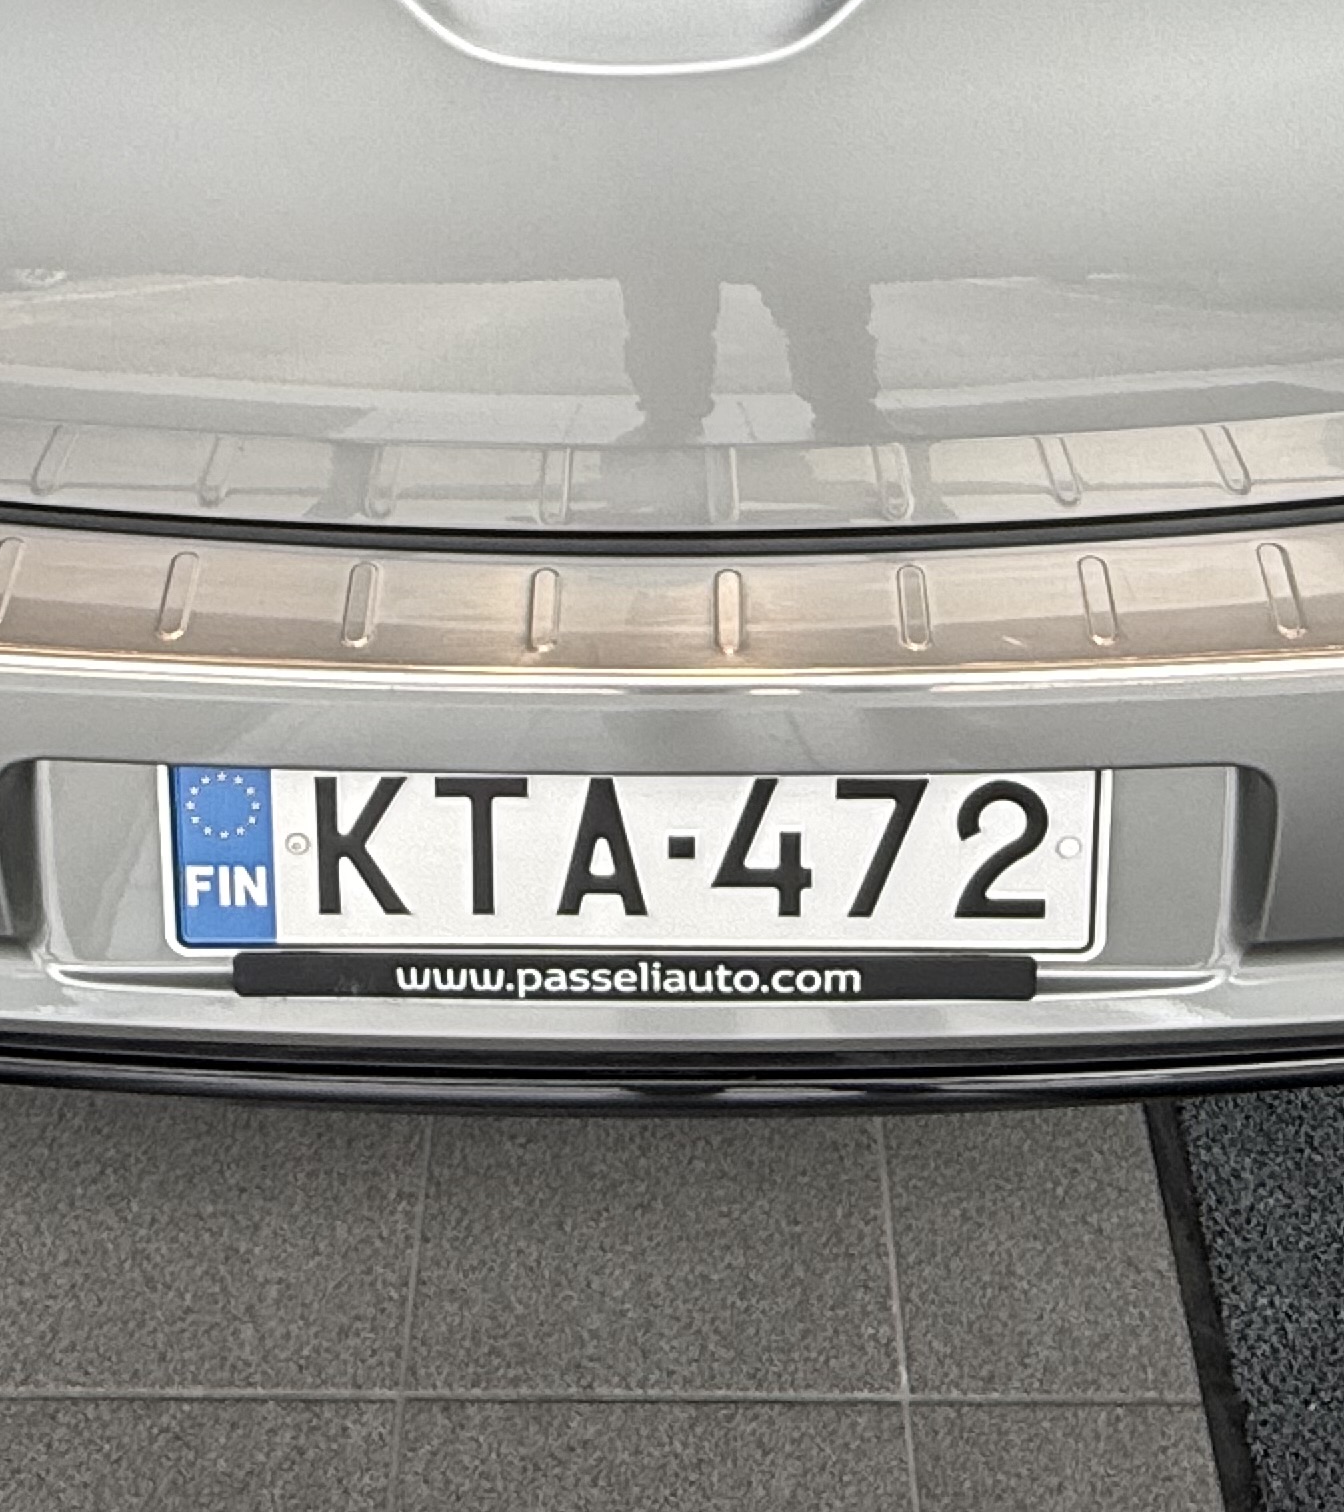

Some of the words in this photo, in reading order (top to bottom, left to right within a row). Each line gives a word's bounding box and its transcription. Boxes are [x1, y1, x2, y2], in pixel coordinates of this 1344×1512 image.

[313, 775, 1049, 919] KTA-472
[184, 864, 269, 908] FIN
[395, 961, 862, 999] www.passeliauto.com
